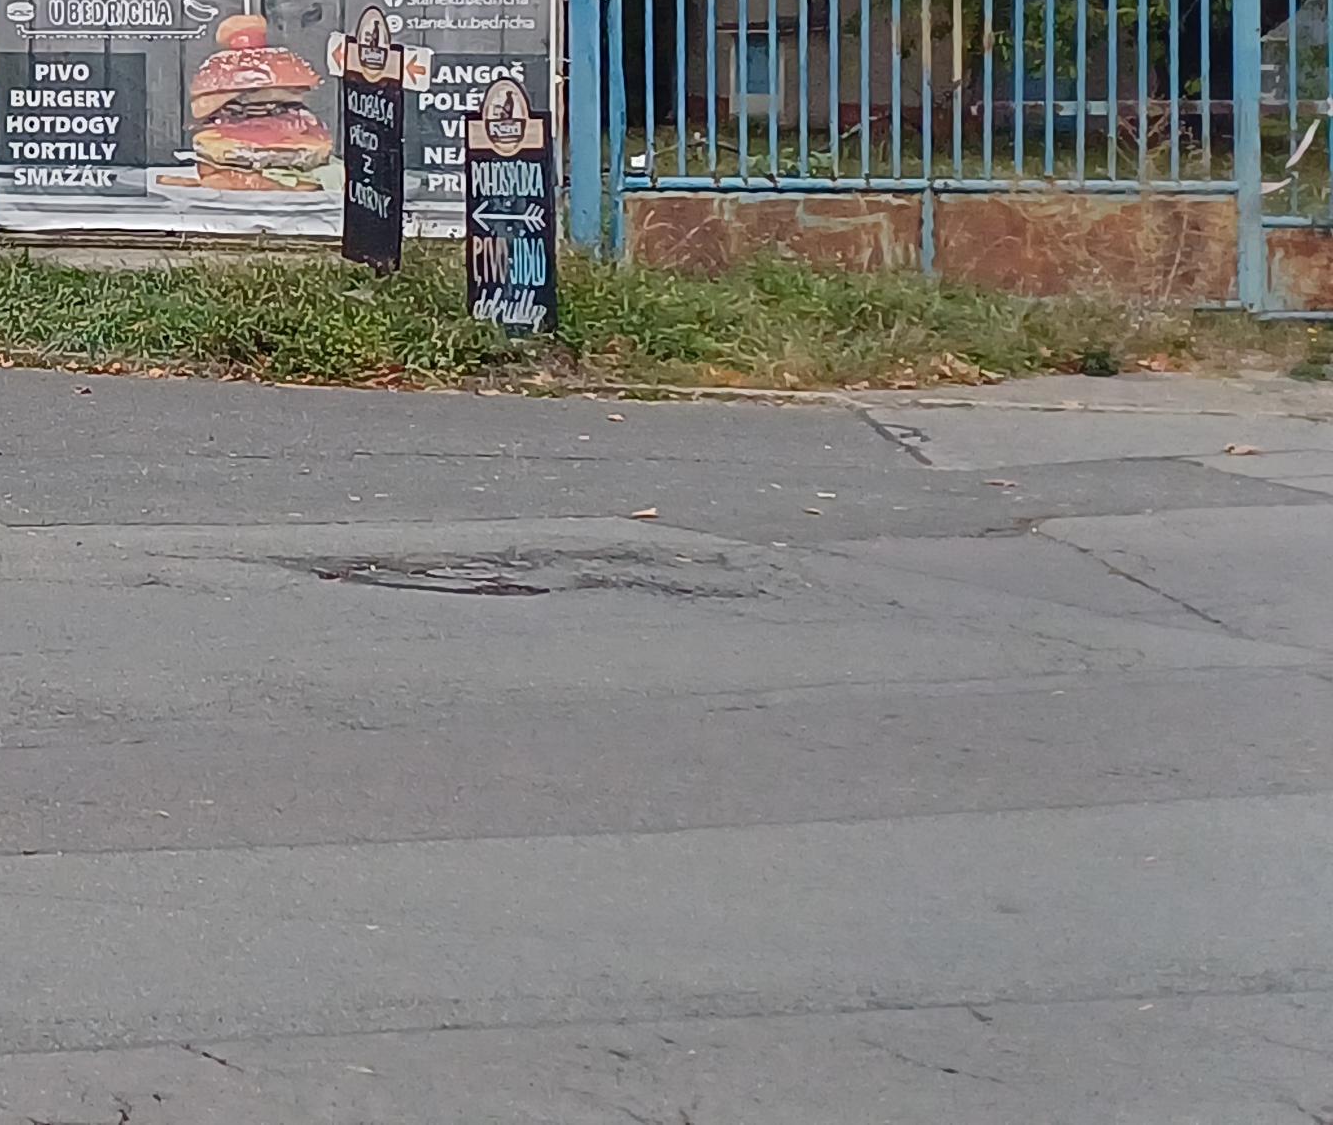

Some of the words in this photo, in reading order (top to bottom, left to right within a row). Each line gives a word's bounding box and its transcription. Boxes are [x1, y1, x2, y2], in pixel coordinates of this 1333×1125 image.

[47, 0, 66, 25] U
[35, 63, 90, 82] PIVO
[432, 61, 524, 84] ANGOŠ
[10, 89, 116, 108] BURGERY
[6, 114, 120, 135] HOTDOGY
[8, 141, 117, 161] TORTILLY
[13, 163, 113, 187] SMAŽÁK
